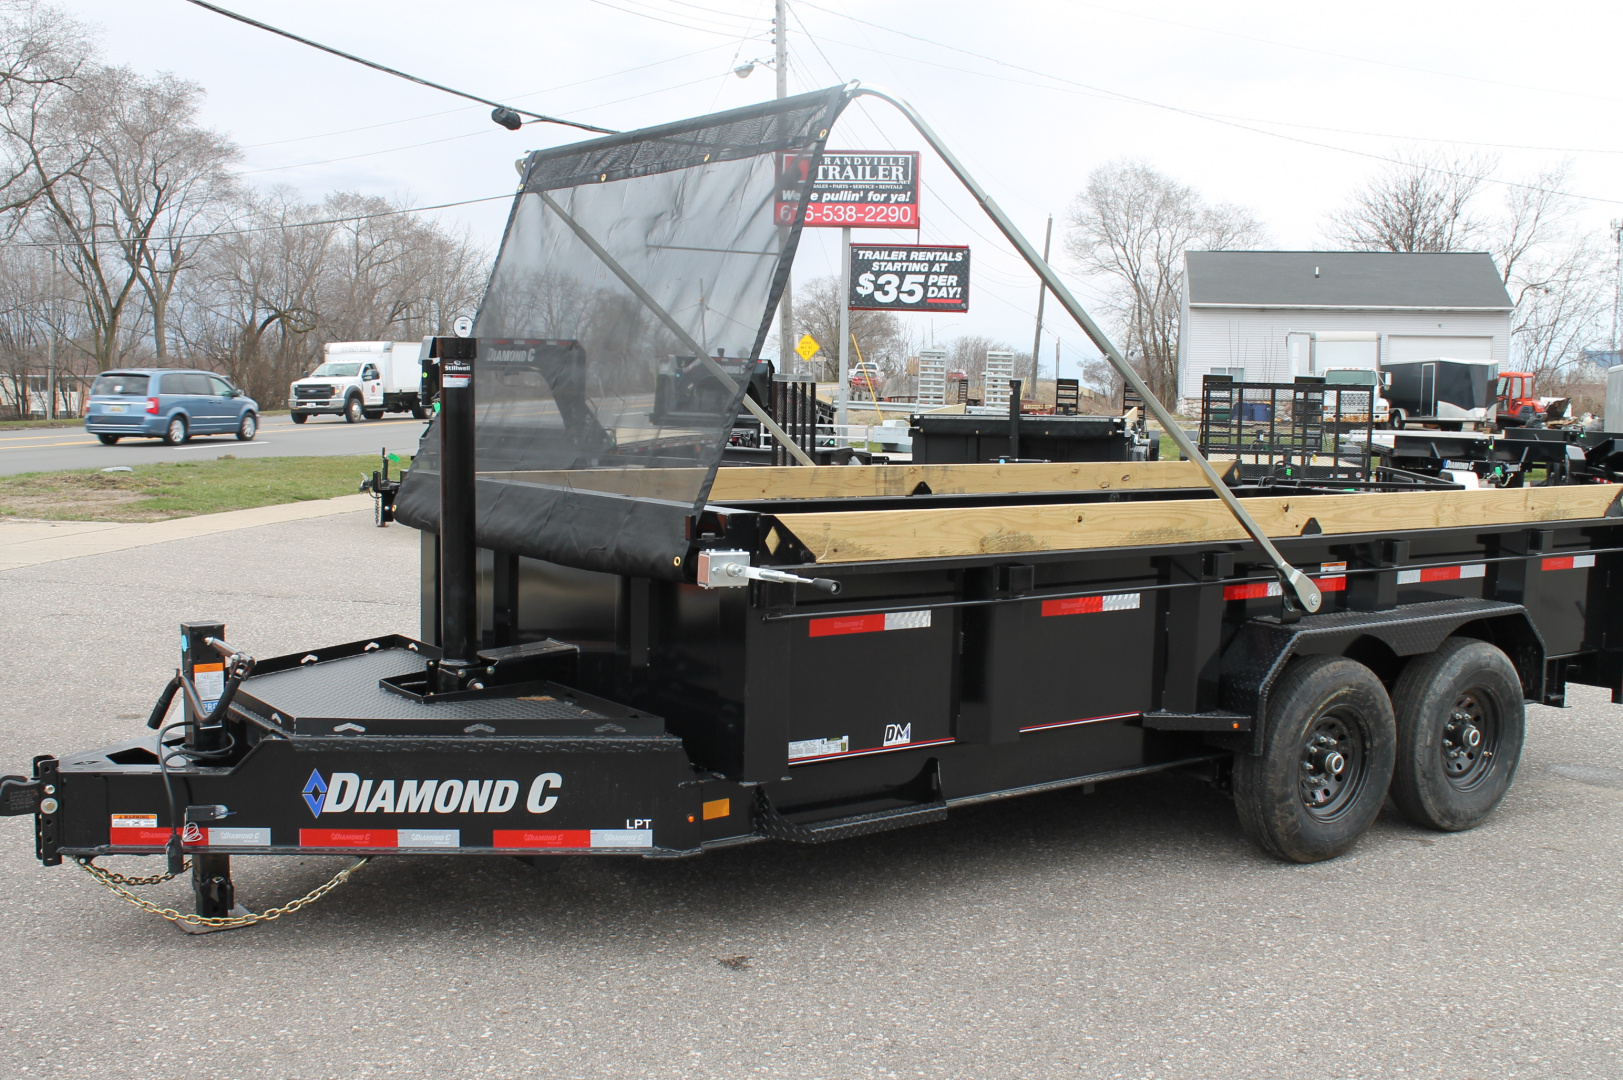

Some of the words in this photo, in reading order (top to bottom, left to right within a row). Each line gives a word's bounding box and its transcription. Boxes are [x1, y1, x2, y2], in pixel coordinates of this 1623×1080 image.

[819, 157, 906, 166] RANDVILLE
[816, 165, 905, 181] TRAILER
[821, 190, 864, 204] pullin'
[867, 190, 888, 202] for
[889, 191, 912, 204] ya!
[857, 250, 907, 261] TRAILER
[909, 251, 963, 262] RENTALS
[871, 261, 929, 272] STARTING
[931, 262, 949, 273] AT
[927, 274, 959, 287] PER
[855, 271, 926, 304] $35
[926, 286, 962, 299] DAY!
[486, 347, 528, 362] DIAMOND
[527, 347, 536, 362] C
[322, 772, 520, 814] DIAMOND
[526, 772, 563, 814] C
[626, 818, 652, 830] LPT
[334, 833, 364, 841] DIAMOND
[414, 833, 445, 841] DIAMOND
[444, 833, 451, 841] C
